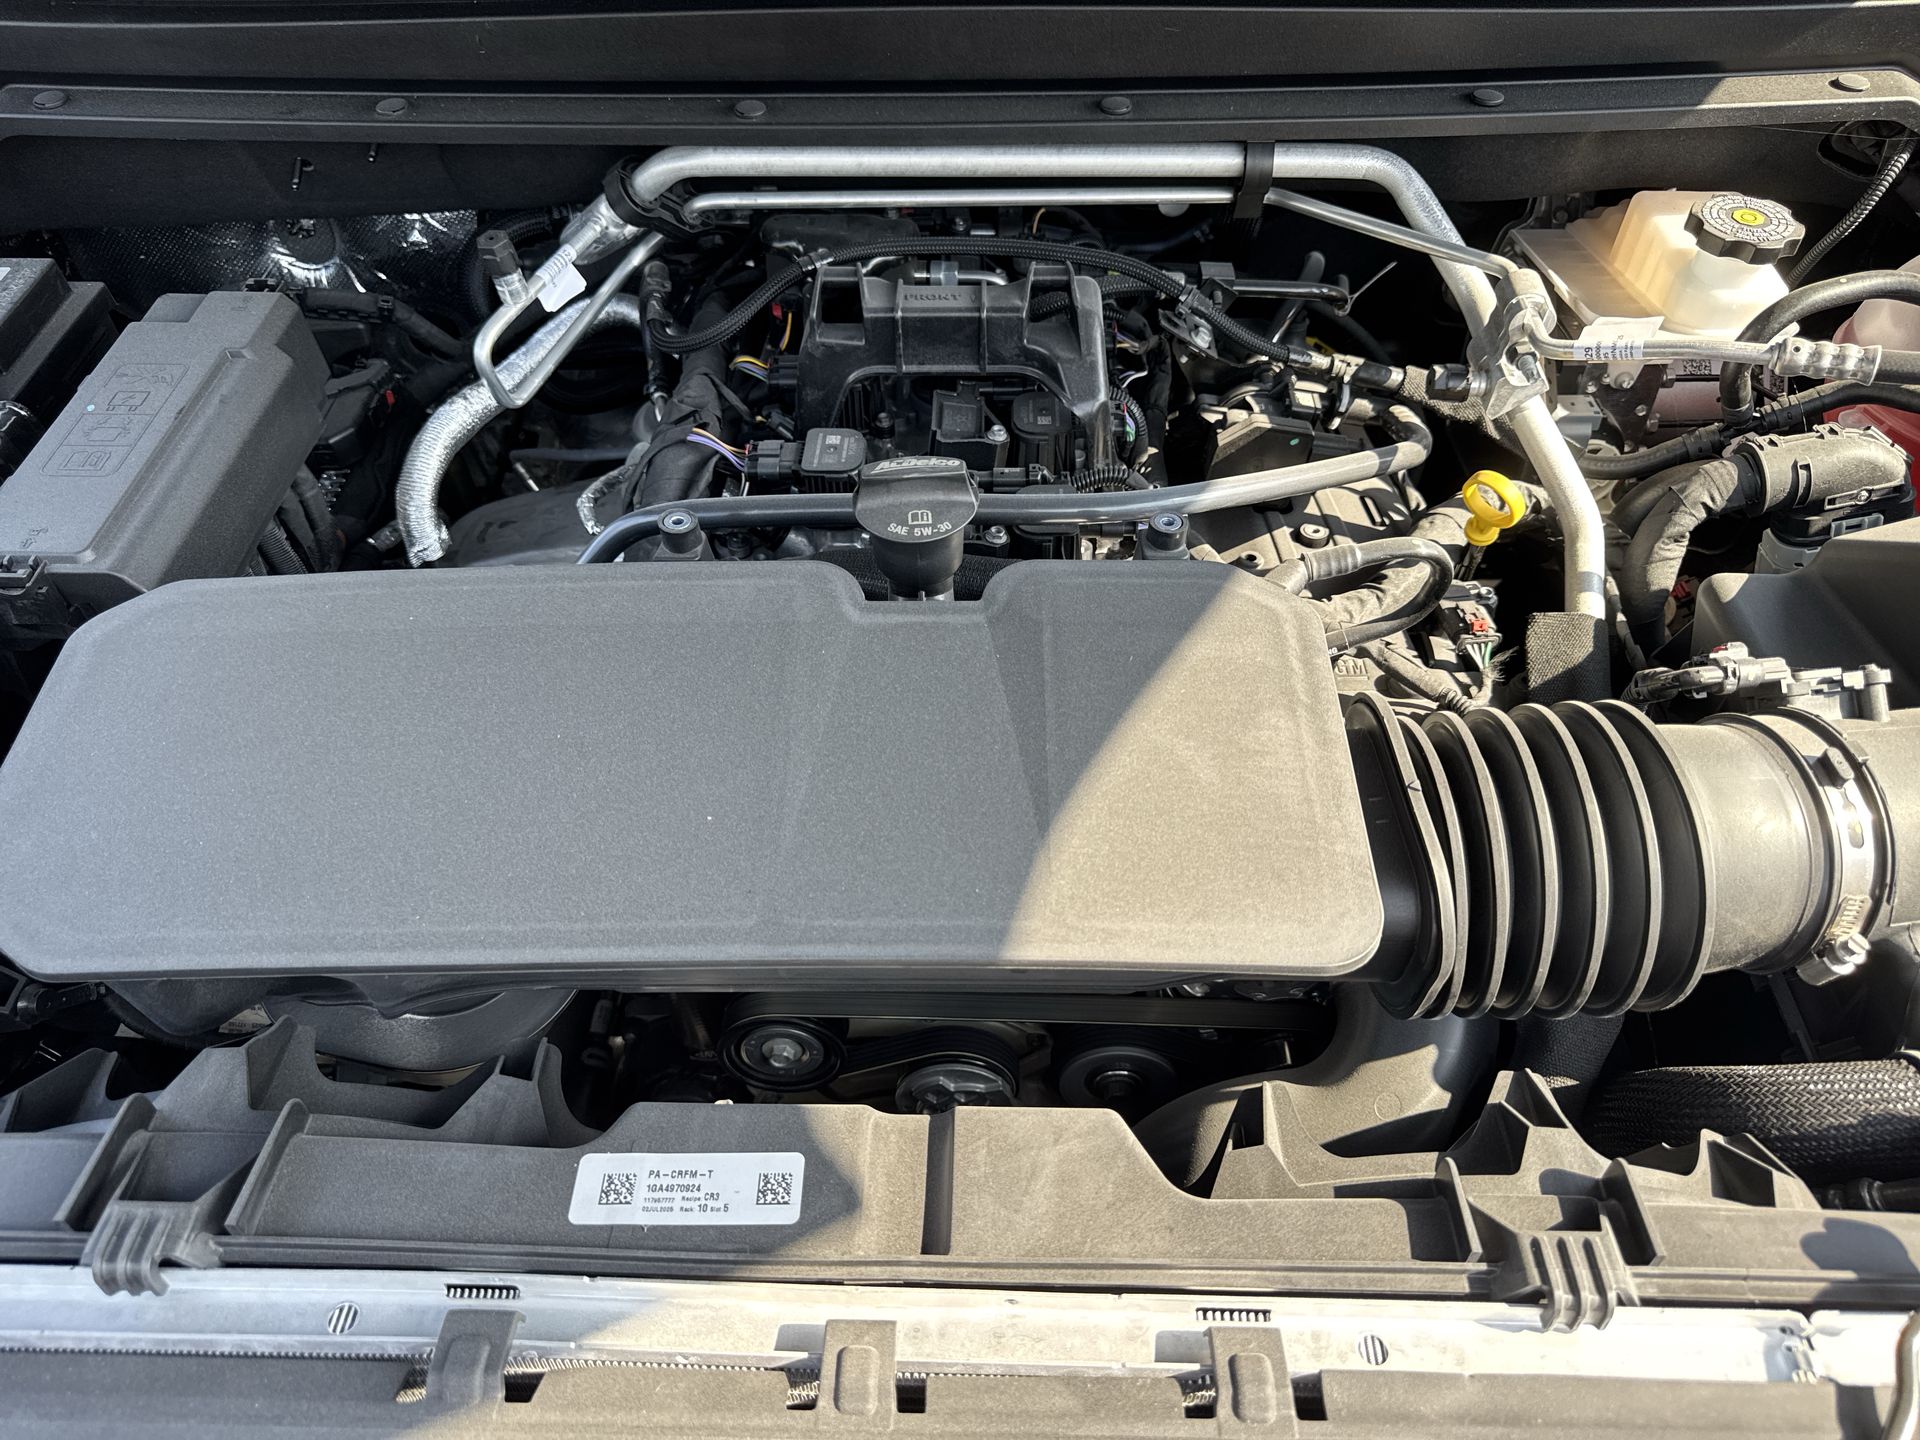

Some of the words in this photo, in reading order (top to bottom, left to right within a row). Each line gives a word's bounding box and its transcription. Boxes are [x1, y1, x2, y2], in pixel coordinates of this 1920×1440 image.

[887, 522, 910, 536] SAE
[914, 521, 952, 537] 5W-30
[704, 1192, 720, 1201] CR3
[698, 1203, 708, 1212] 10
[723, 1203, 729, 1212] 5
